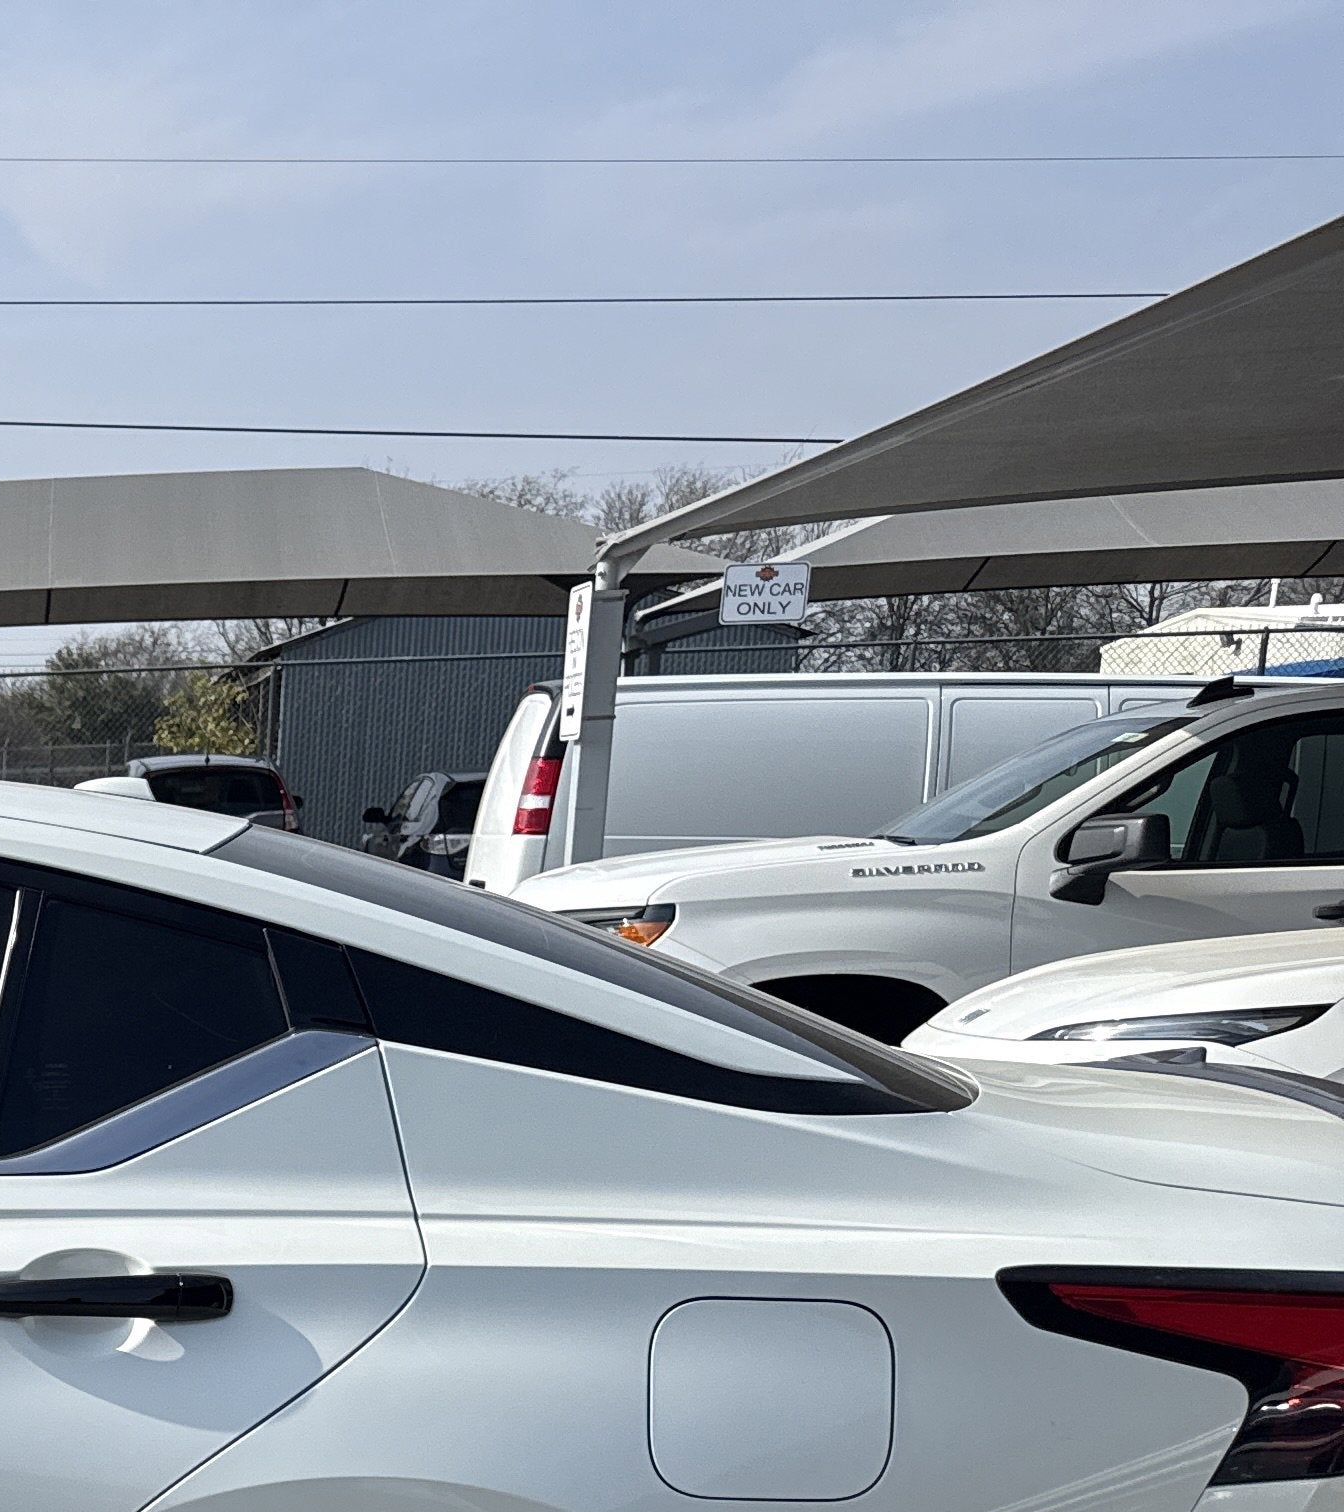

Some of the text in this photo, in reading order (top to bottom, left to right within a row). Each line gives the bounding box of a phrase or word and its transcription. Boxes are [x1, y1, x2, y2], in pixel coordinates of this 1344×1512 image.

[726, 582, 804, 597] NEW CAR
[737, 601, 791, 615] ONLY
[849, 862, 985, 878] SILVERADO
